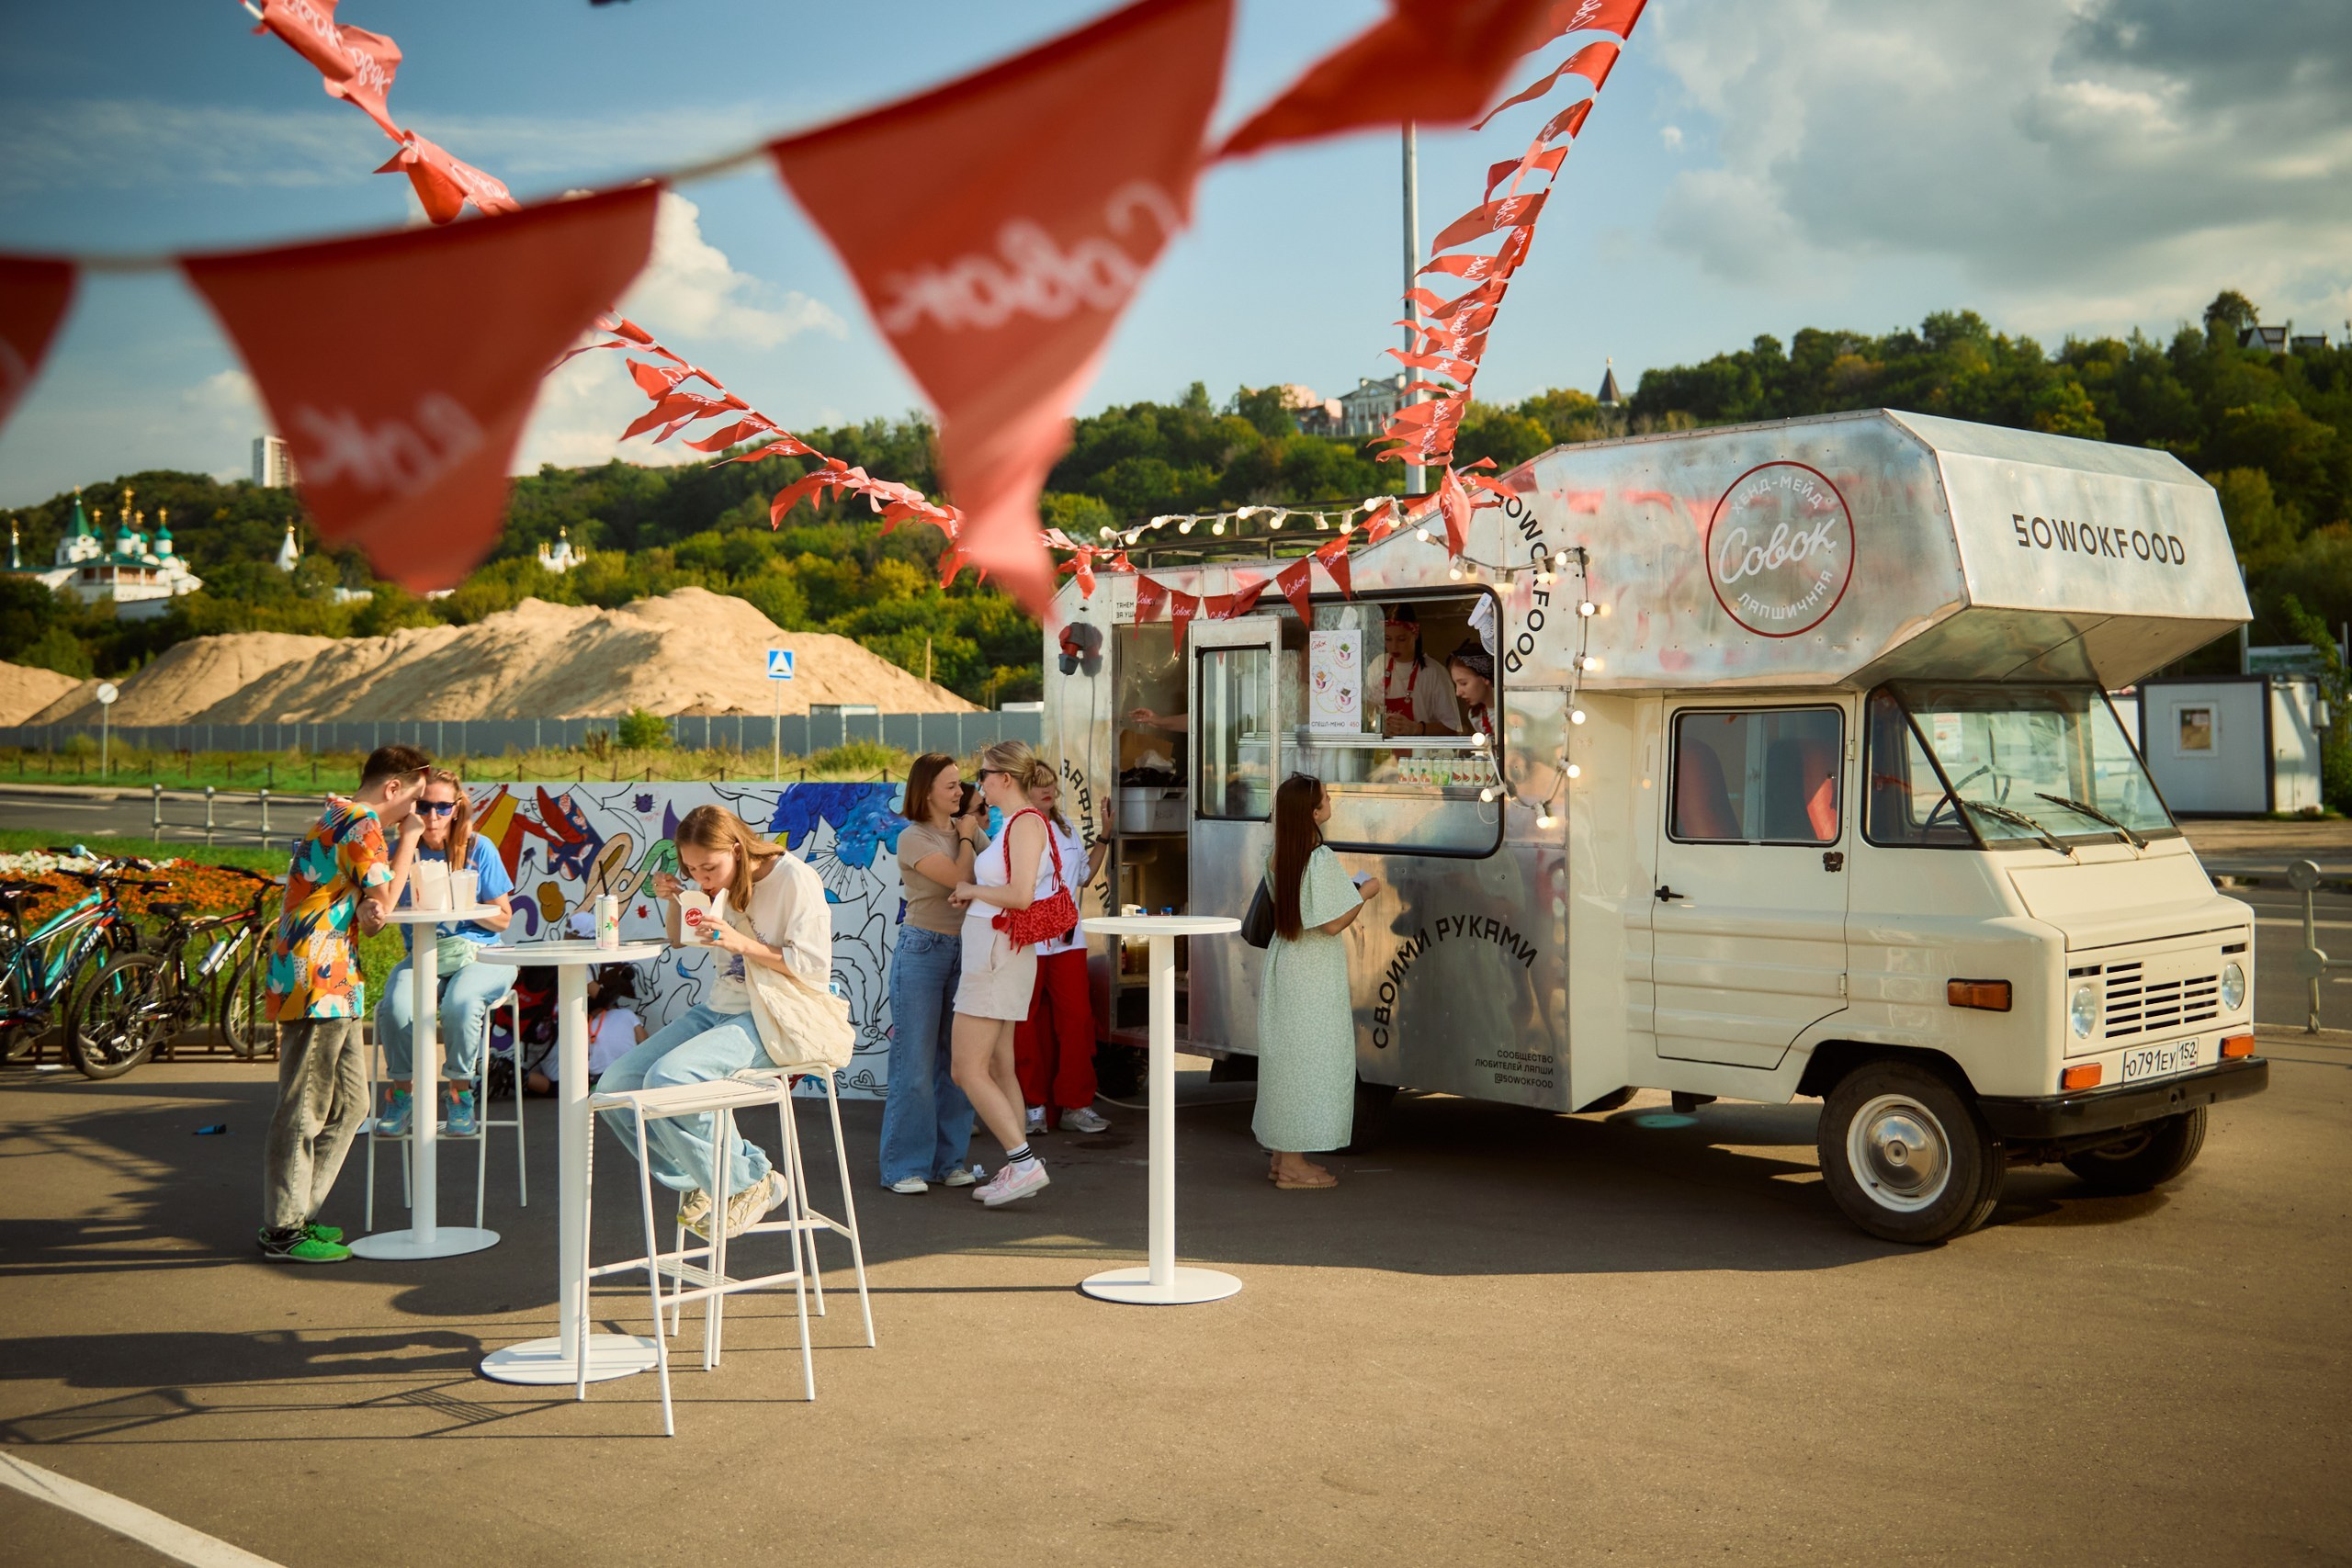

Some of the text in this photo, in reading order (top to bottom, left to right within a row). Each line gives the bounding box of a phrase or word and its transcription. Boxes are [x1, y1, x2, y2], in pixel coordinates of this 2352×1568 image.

[1732, 476, 1823, 515] ХЕНД-МЕЙД
[1718, 518, 1838, 584] Совок
[1737, 570, 1833, 620] ЛАПШИЧНАЯ
[1373, 915, 1538, 1049] СВОИМИ РУКАМИ
[1475, 1058, 1555, 1077] ЛЮБИТЕЛЕЙ ЛАПШИ
[1497, 1049, 1555, 1065] СООБЩЕСТВО
[2178, 1042, 2196, 1060] 152
